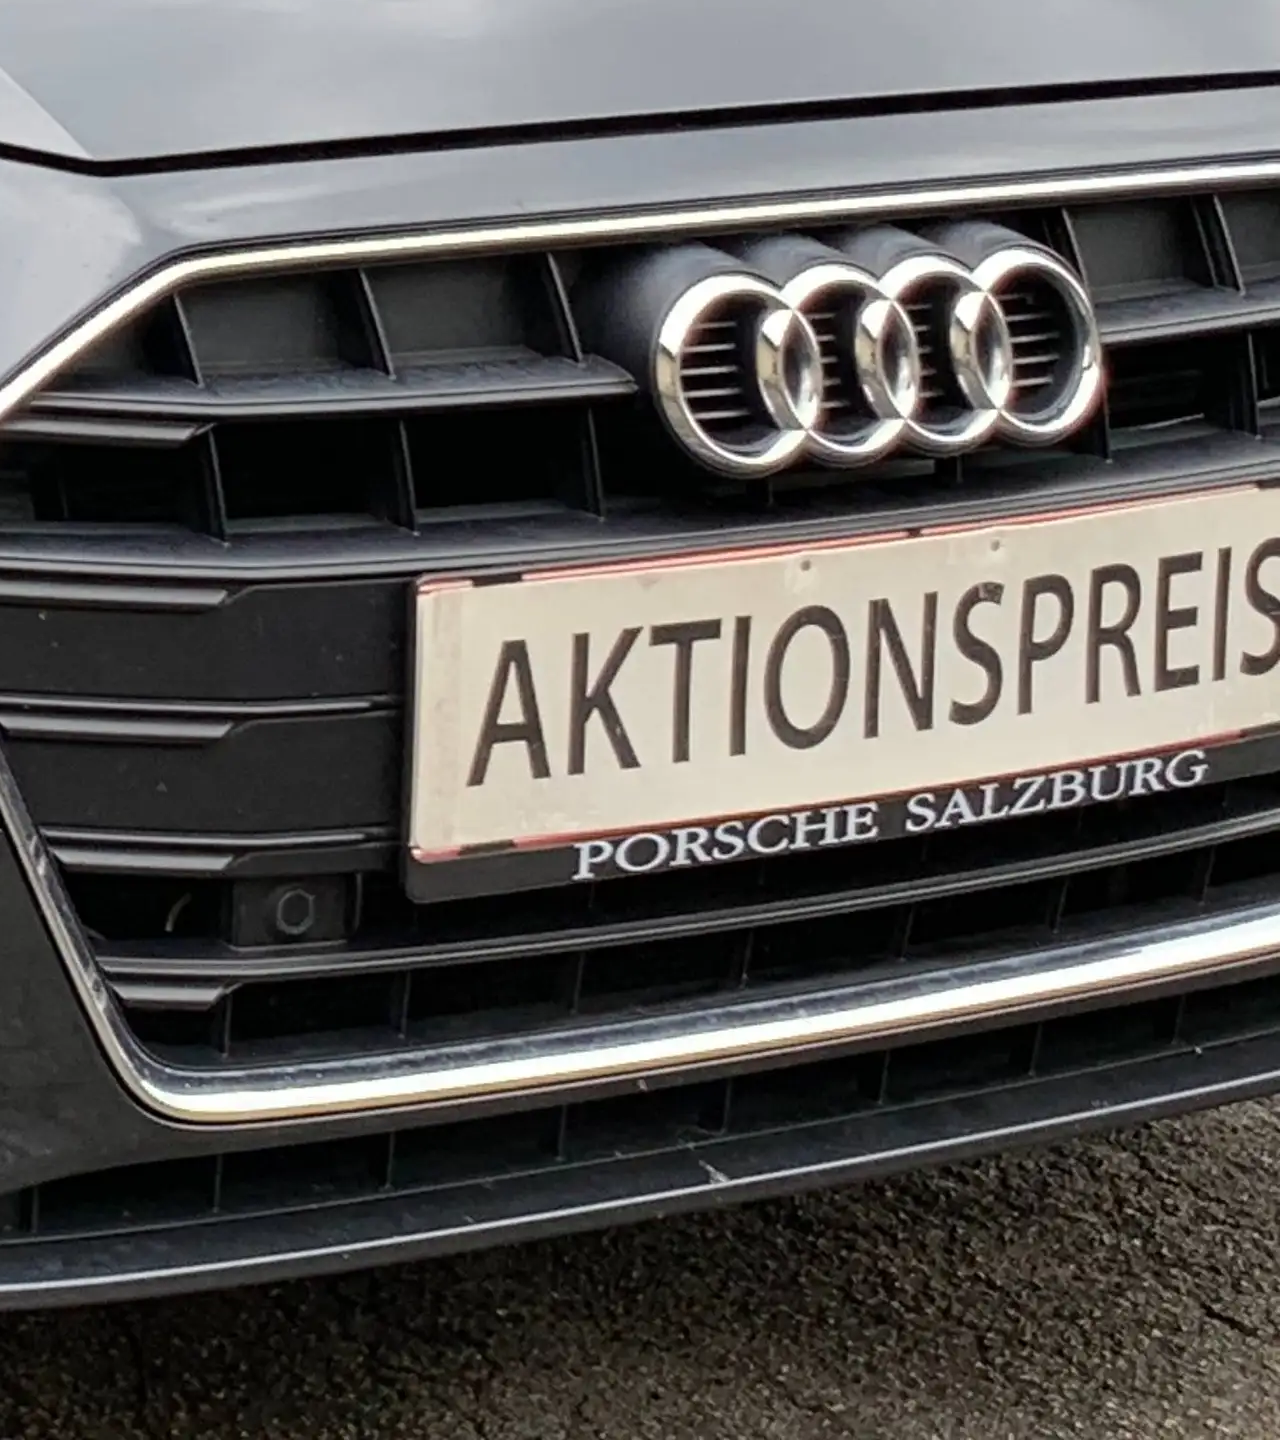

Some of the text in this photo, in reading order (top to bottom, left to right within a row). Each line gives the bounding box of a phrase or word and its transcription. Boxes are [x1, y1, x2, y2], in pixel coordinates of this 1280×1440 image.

[466, 537, 1280, 787] AKTIONSPREIS
[571, 749, 1209, 882] PORSCHE SALZBURG
